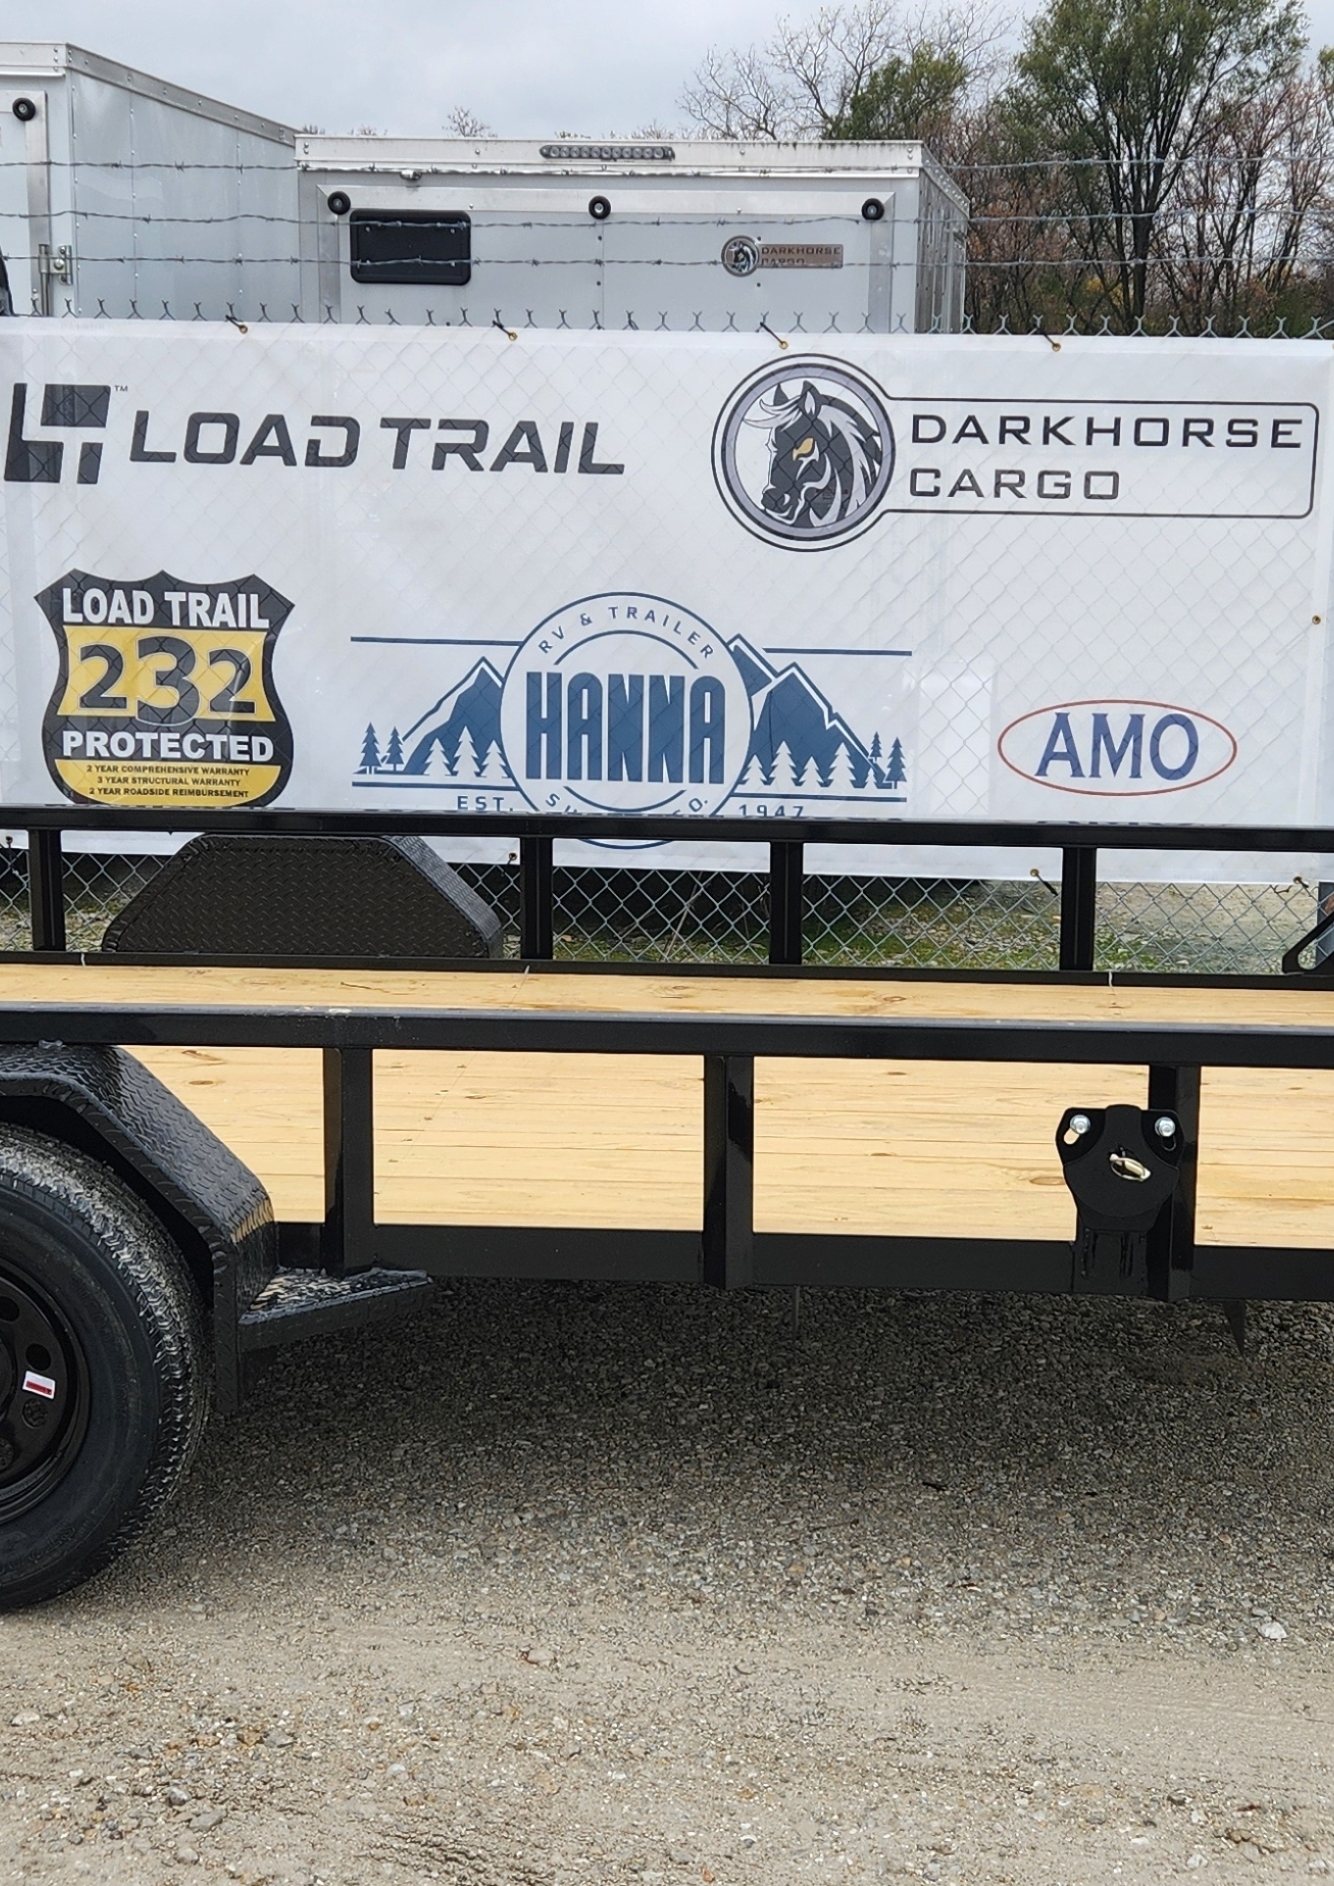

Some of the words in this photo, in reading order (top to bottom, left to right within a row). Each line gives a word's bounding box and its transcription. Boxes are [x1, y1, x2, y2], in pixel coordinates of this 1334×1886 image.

[761, 246, 841, 255] DARKHORSE
[129, 410, 362, 468] LOAD
[379, 416, 626, 475] TRAIL
[910, 413, 1303, 449] DARKHORSE
[909, 468, 1120, 501] CARGO
[62, 588, 155, 626] LOAD
[164, 590, 270, 629] TRAIL
[538, 626, 566, 654] RV
[579, 613, 593, 627] &
[608, 605, 715, 660] TRAILER
[77, 636, 257, 727] 232
[525, 671, 726, 785] HANNA
[62, 730, 274, 763] PROTECTED
[1034, 711, 1199, 781] AMO
[87, 764, 92, 772] 2
[95, 765, 119, 773] YEAR
[121, 765, 200, 775] COMPREHENSIVE
[201, 767, 250, 776] WARRANTY
[97, 776, 103, 784] 3
[106, 776, 130, 785] YEAR
[131, 776, 189, 786] STRUCTURAL
[190, 778, 241, 787] WARRANTY
[89, 787, 95, 795] 2
[98, 788, 121, 796] YEAR
[123, 788, 170, 796] ROADSIDE
[172, 789, 249, 798] REIMBURSEMENT
[456, 796, 514, 812] EST.
[739, 804, 805, 818] 1947
